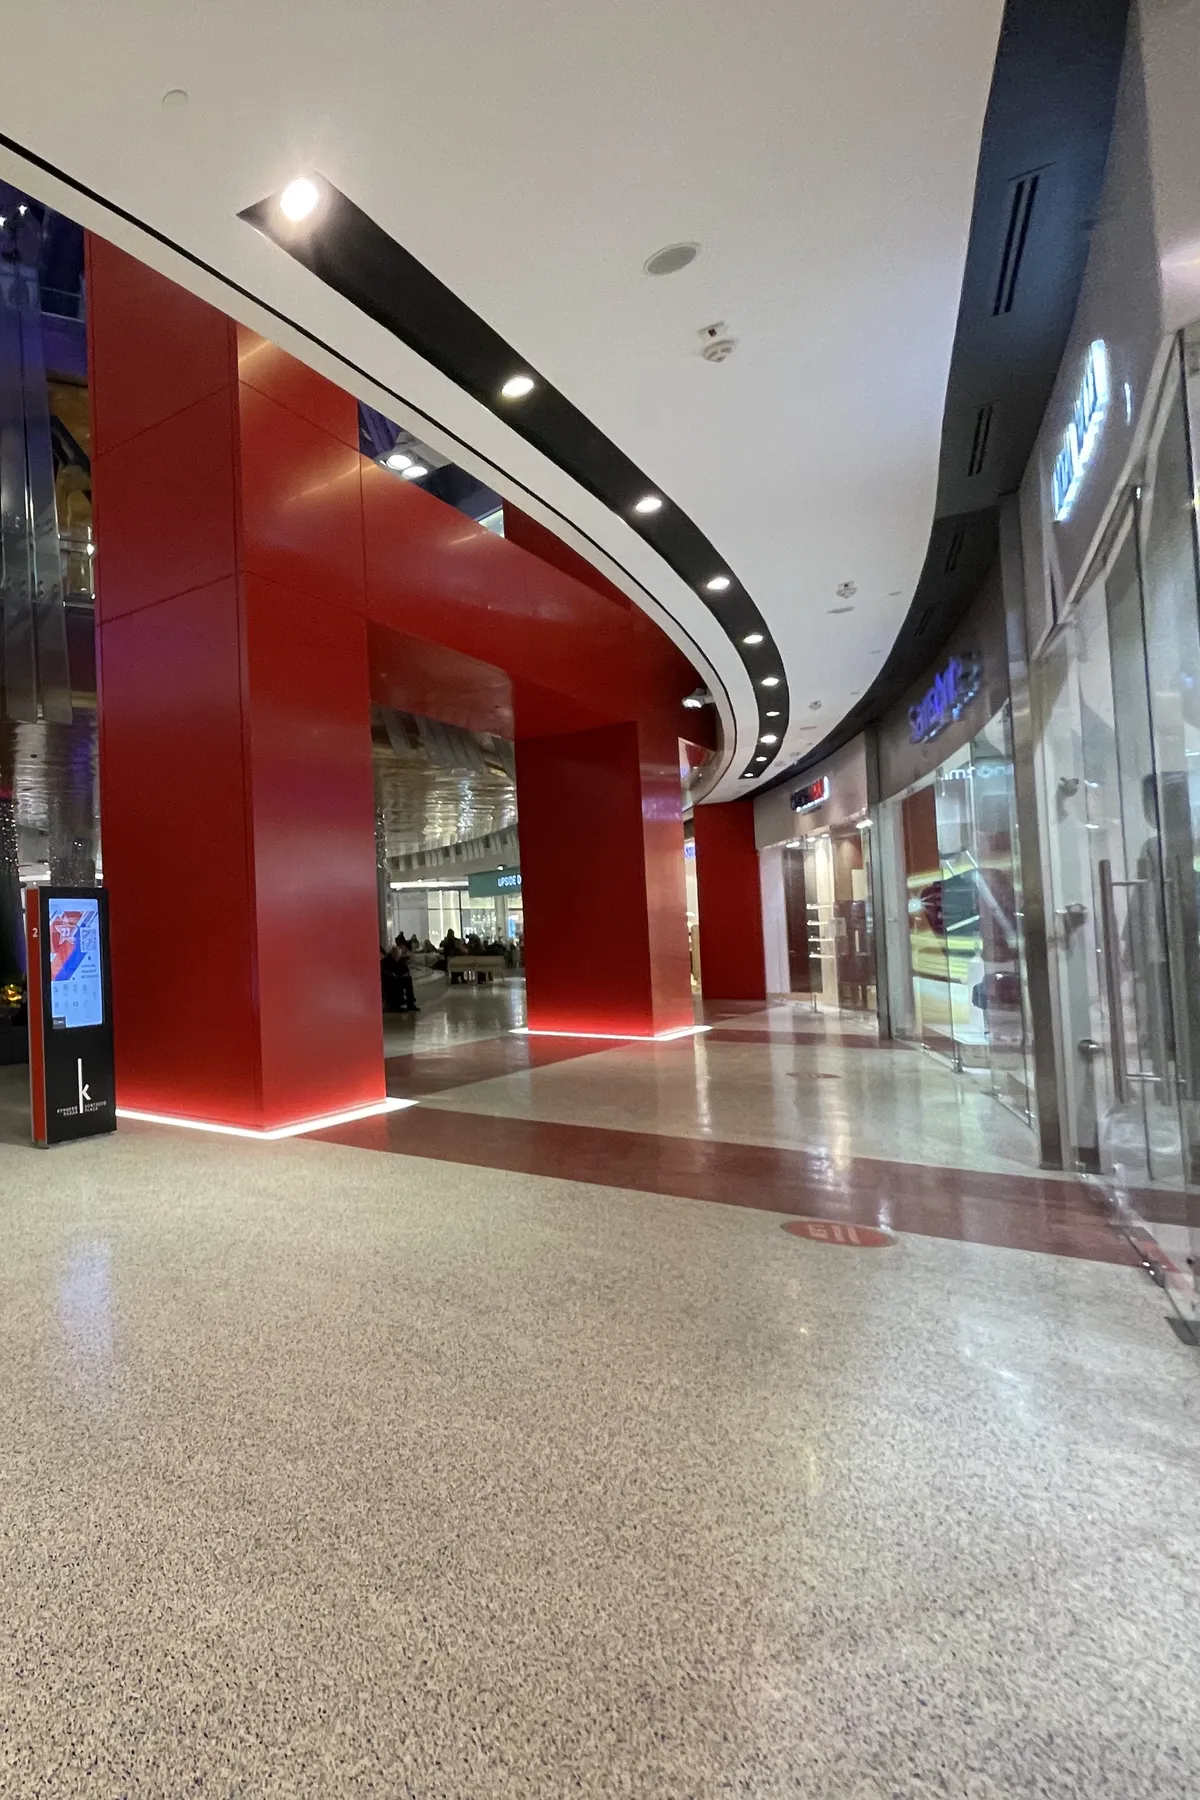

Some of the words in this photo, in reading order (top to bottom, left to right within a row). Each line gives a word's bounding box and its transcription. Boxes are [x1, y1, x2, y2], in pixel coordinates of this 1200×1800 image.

[497, 875, 516, 887] UPSIDE
[32, 927, 39, 938] 2
[77, 1057, 92, 1114] k
